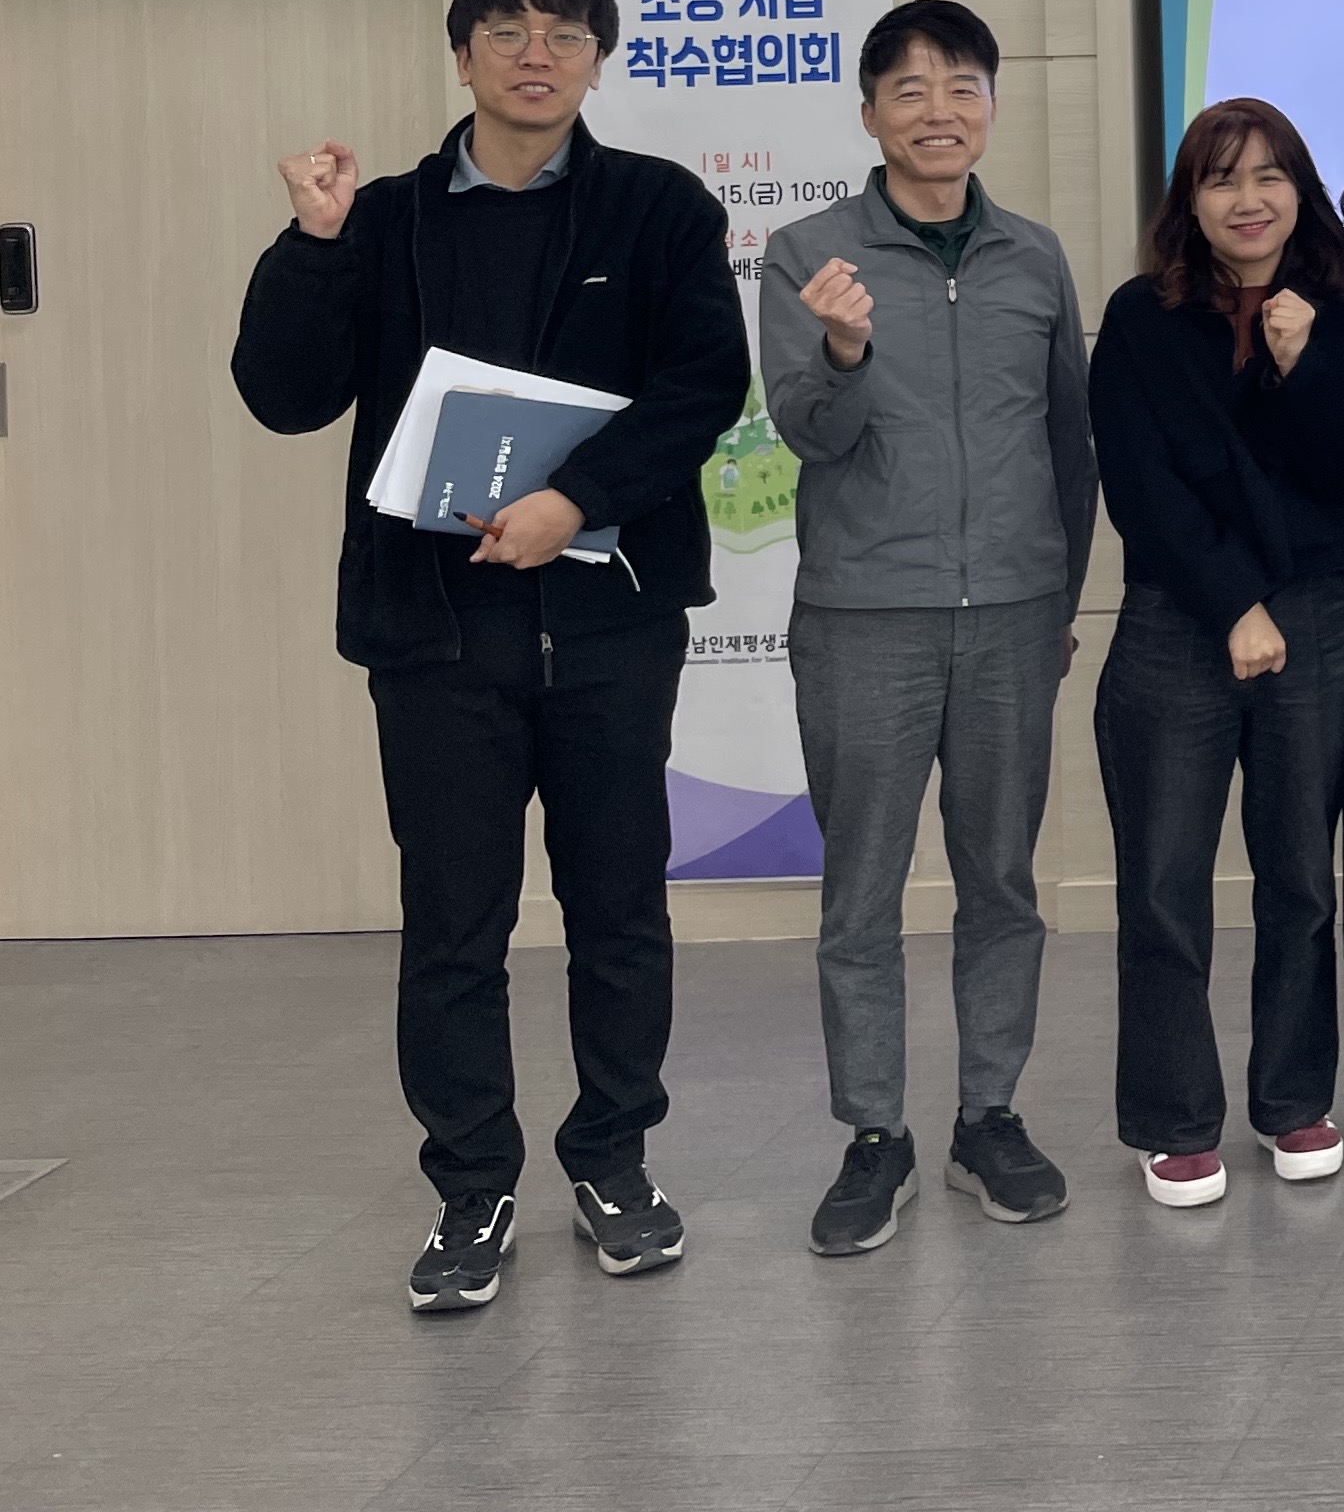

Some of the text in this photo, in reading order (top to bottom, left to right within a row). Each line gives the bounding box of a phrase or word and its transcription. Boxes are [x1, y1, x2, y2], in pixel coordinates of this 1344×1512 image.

[627, 33, 840, 87] 착수협의회
[791, 181, 848, 201] 10:00
[488, 475, 504, 499] 2024
[686, 634, 789, 654] 남인재평생교
